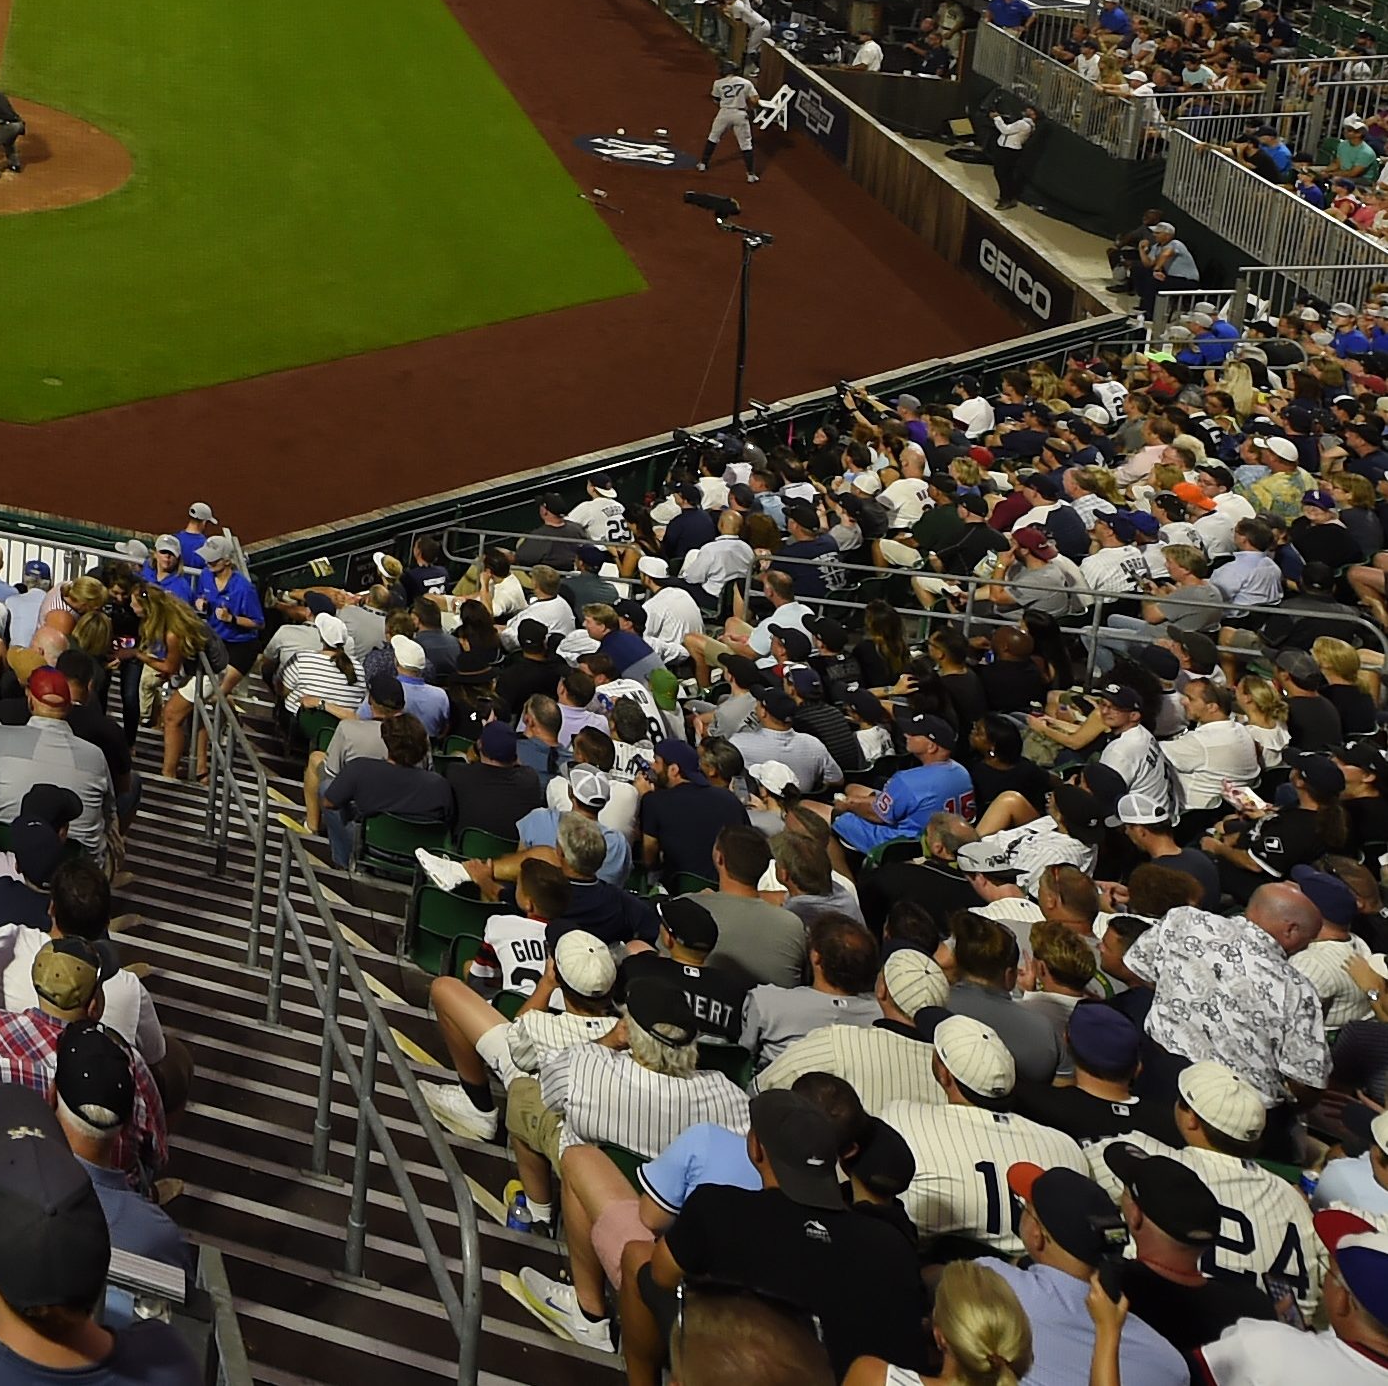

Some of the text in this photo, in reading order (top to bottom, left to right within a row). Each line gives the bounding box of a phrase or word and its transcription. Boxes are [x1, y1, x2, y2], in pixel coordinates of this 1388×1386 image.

[722, 83, 745, 99] 27
[979, 238, 1052, 320] GEICO
[510, 939, 545, 963] GIO
[1197, 1203, 1309, 1292] 24
